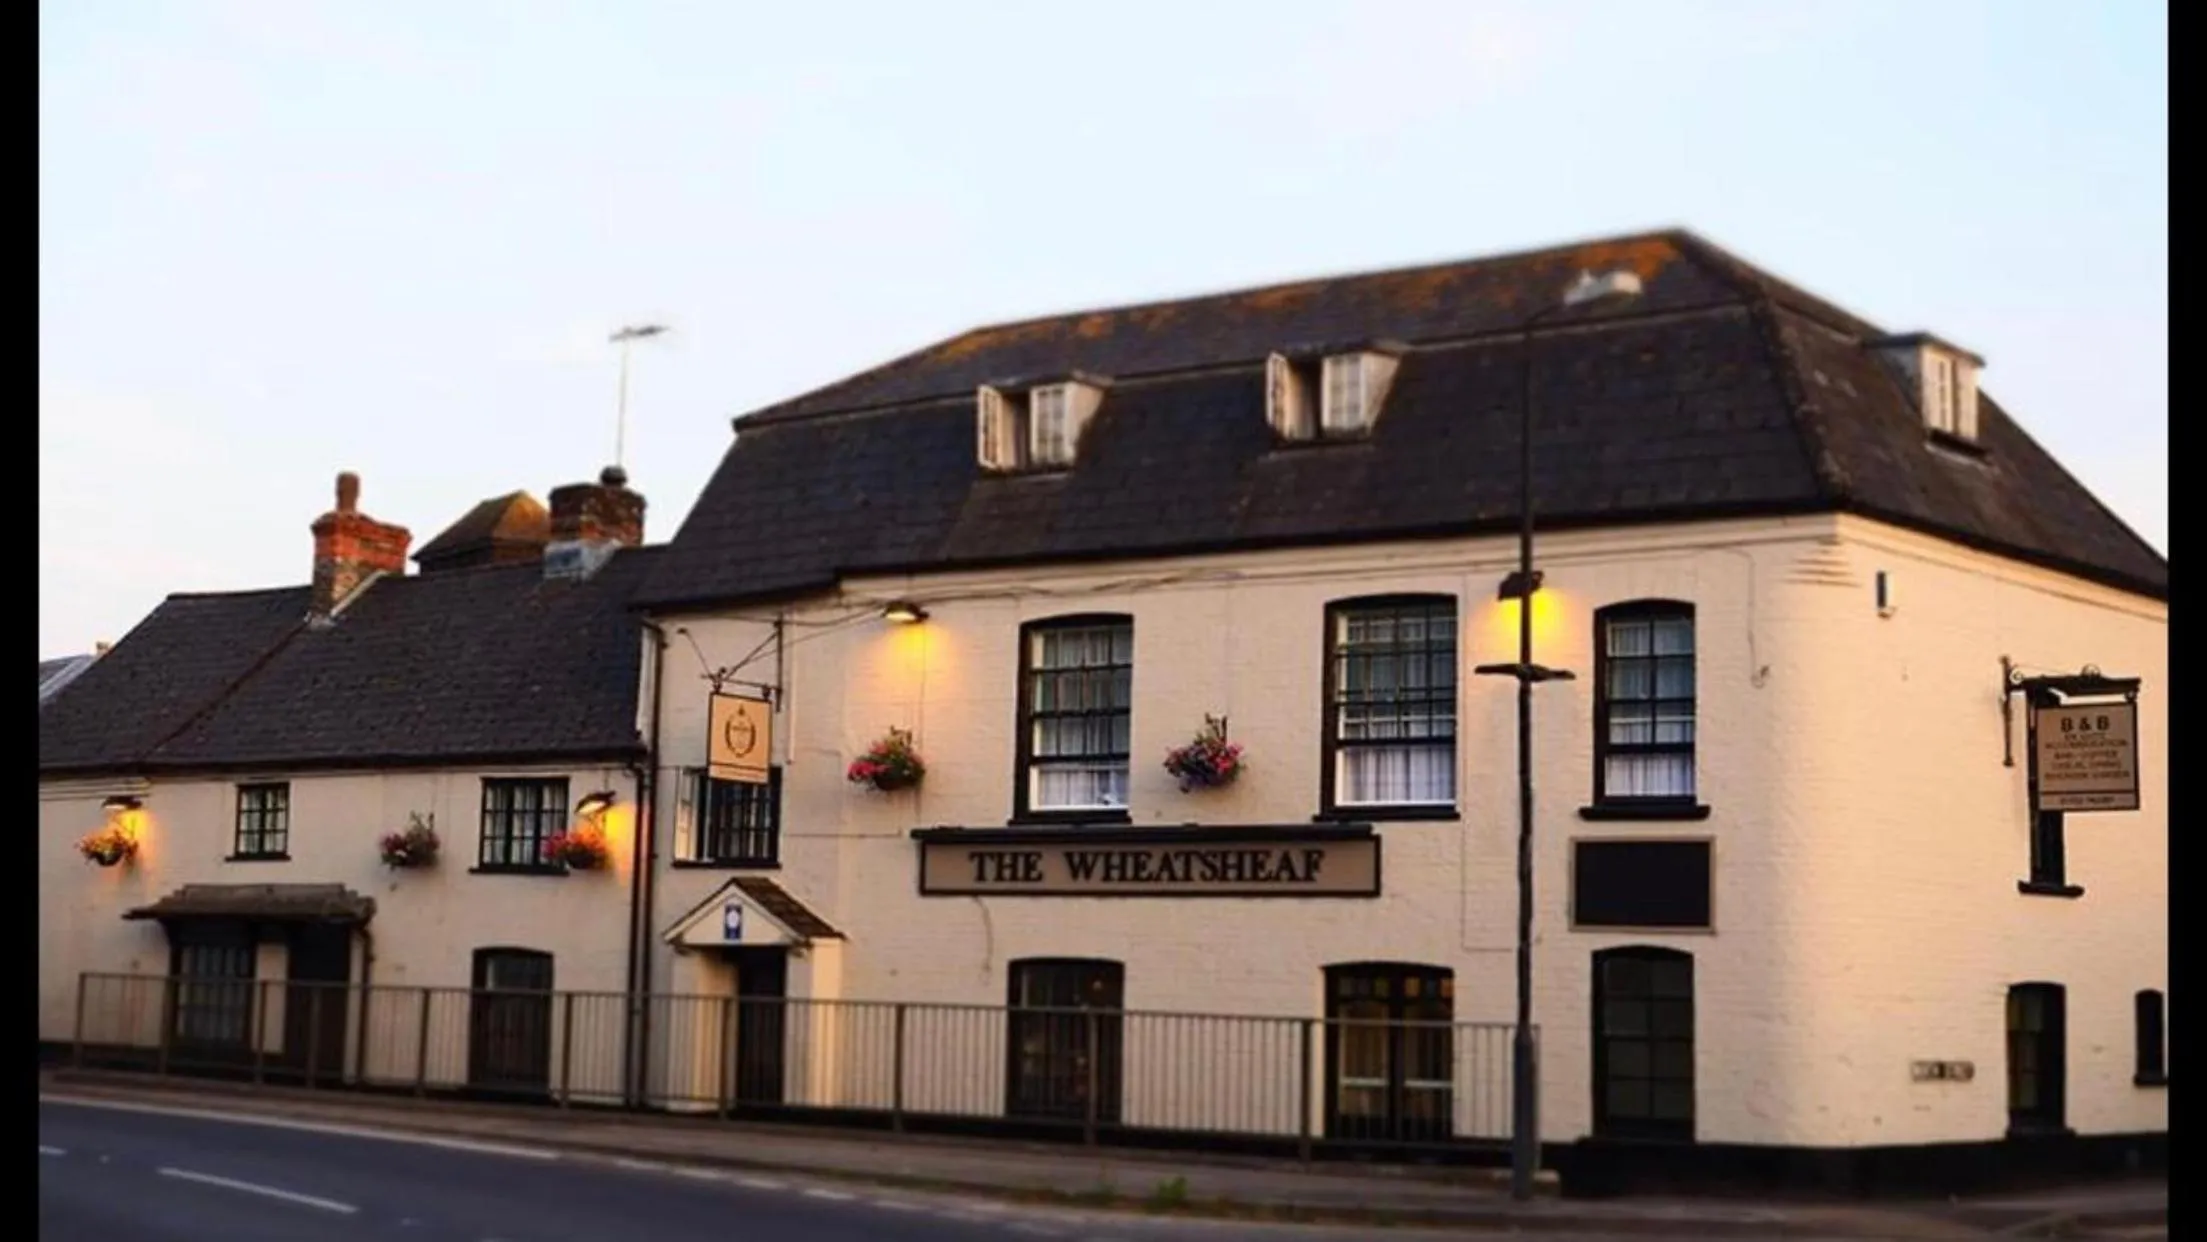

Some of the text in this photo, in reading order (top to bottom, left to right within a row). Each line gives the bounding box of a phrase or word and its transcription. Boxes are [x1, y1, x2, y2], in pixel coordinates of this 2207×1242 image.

[2061, 715, 2110, 732] B & B
[968, 849, 1326, 884] THE WHEATSHEAF
